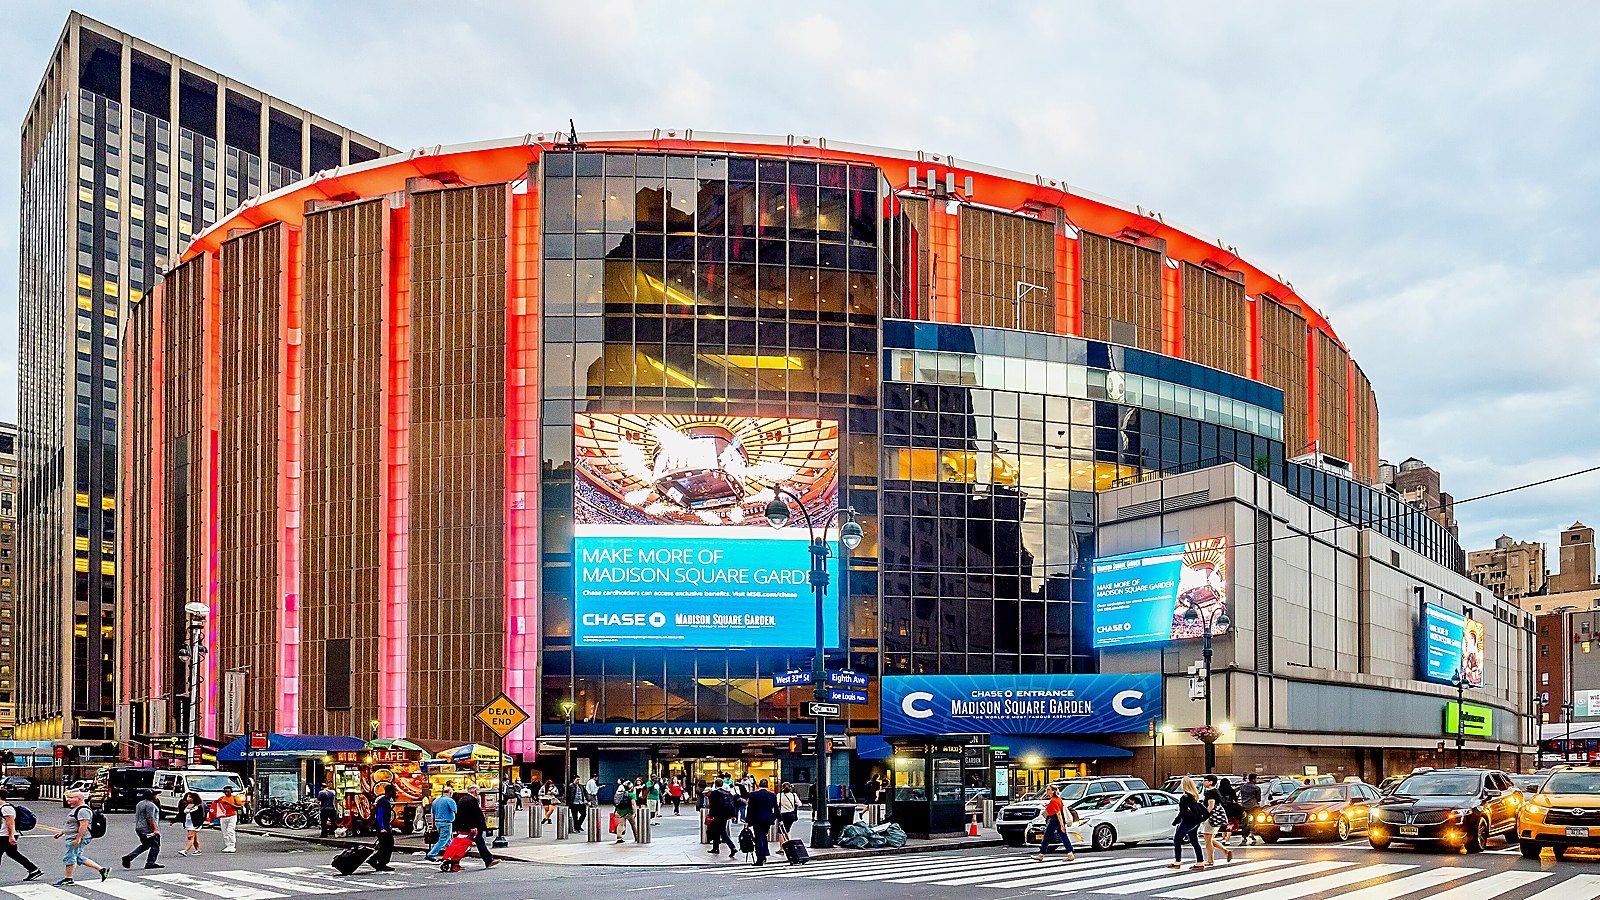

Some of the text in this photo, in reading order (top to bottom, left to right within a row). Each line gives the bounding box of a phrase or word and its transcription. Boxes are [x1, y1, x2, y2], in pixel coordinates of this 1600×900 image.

[583, 548, 724, 565] MAKE MORE OF
[583, 567, 815, 586] MADISON SQUARE GARDE
[1096, 578, 1141, 591] MAKE MORE OF
[1096, 581, 1174, 597] MADISON SQUARE GARDEN
[602, 589, 640, 597] cardholders
[582, 613, 647, 626] CHASE
[675, 613, 711, 625] MADISON
[712, 614, 743, 626] SQUARE
[1096, 623, 1123, 634] CHASE
[776, 676, 791, 684] West
[803, 674, 810, 682] St
[831, 673, 866, 685] Eighth Ave
[831, 691, 842, 700] Joe
[843, 693, 857, 701] Louis
[971, 690, 1003, 698] CHASE
[901, 691, 934, 719] C
[951, 699, 1001, 715] MADISON
[1004, 699, 1046, 715] SQUARE
[1112, 689, 1144, 716] C
[488, 707, 516, 716] DEAD
[491, 717, 512, 726] END
[614, 726, 775, 735] PENNSYLVANIA STATION
[368, 751, 409, 761] ALAFEL
